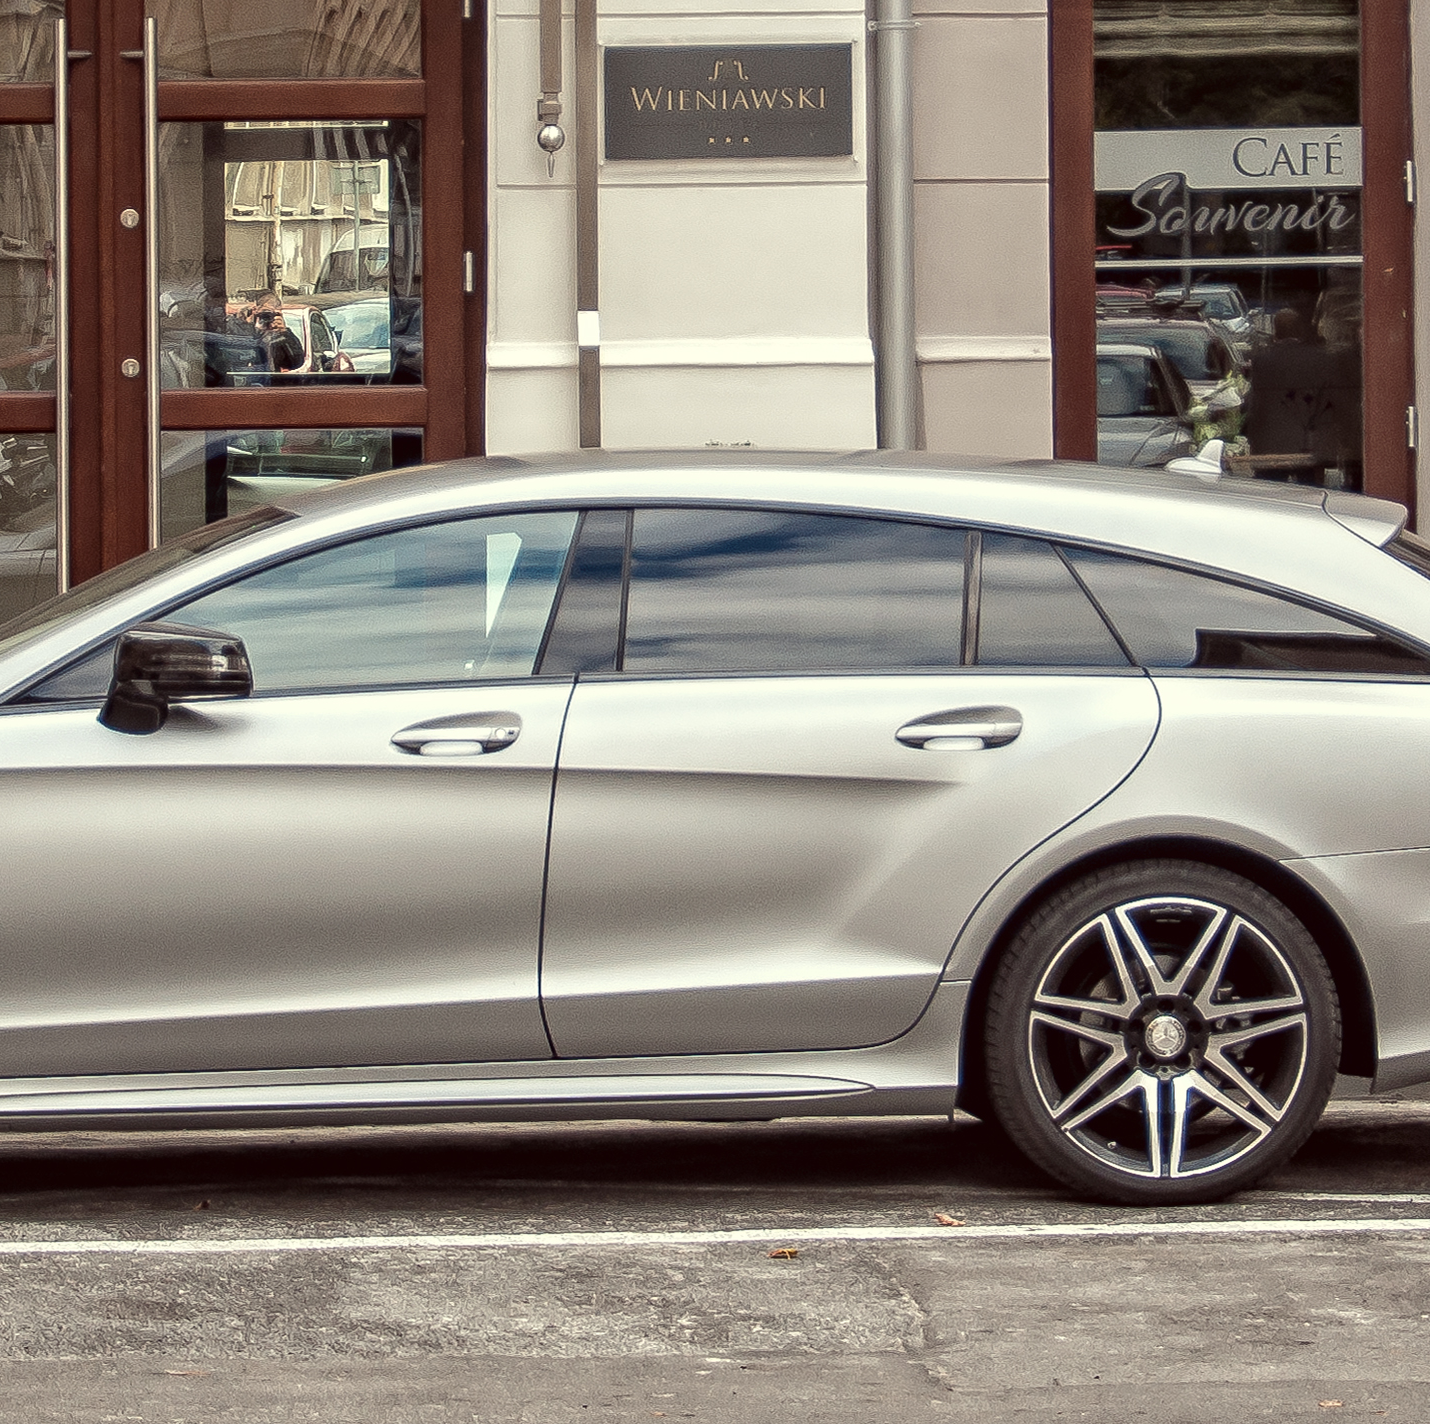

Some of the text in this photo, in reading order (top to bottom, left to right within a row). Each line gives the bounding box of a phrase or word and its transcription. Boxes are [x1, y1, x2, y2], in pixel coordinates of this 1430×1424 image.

[630, 87, 826, 111] WIENIAWSKI
[1232, 133, 1344, 177] CAFÉ
[1107, 172, 1355, 236] Souvenir
